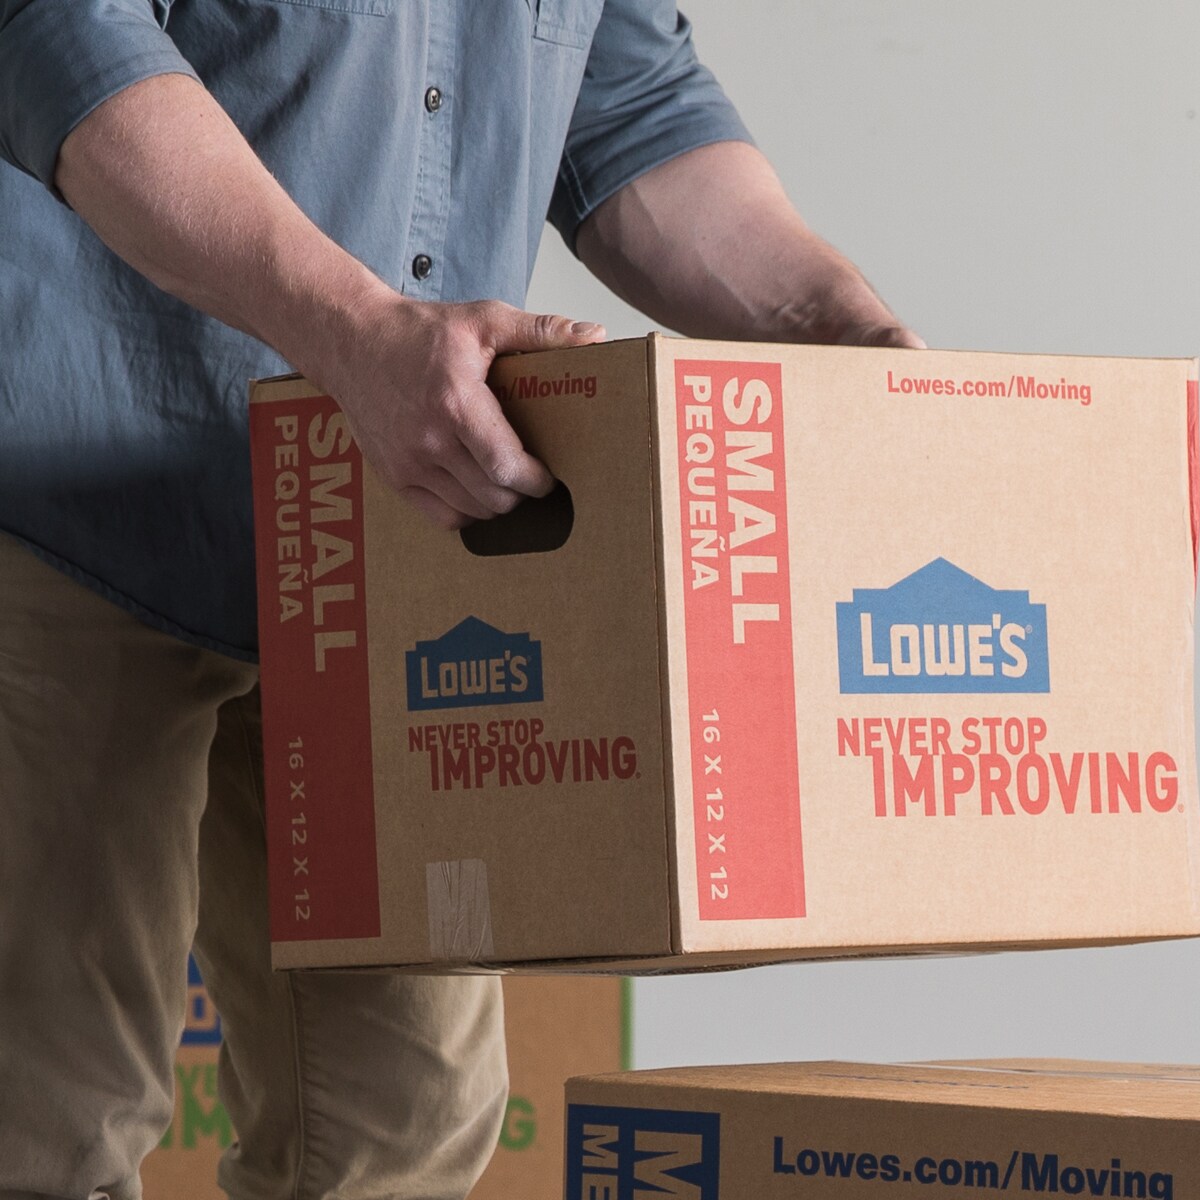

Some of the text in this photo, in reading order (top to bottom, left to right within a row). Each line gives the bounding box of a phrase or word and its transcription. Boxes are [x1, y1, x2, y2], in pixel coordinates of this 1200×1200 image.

[887, 371, 1091, 406] Lowes.com/Moving
[683, 375, 726, 591] PEQUEÑA
[723, 376, 780, 645] SMALL
[274, 415, 309, 624] PEQUEÑA
[308, 411, 357, 673] SMALL
[420, 650, 528, 699] LOWE'S
[860, 612, 1028, 679] LOWE'S
[408, 718, 544, 754] NEVER STOP
[429, 737, 636, 791] IMPROVING
[836, 716, 1047, 757] NEVER STOP
[701, 708, 729, 901] 16 X 12 X 12
[871, 751, 1179, 817] IMPROVING
[288, 736, 311, 922] 16 X 12 X 12
